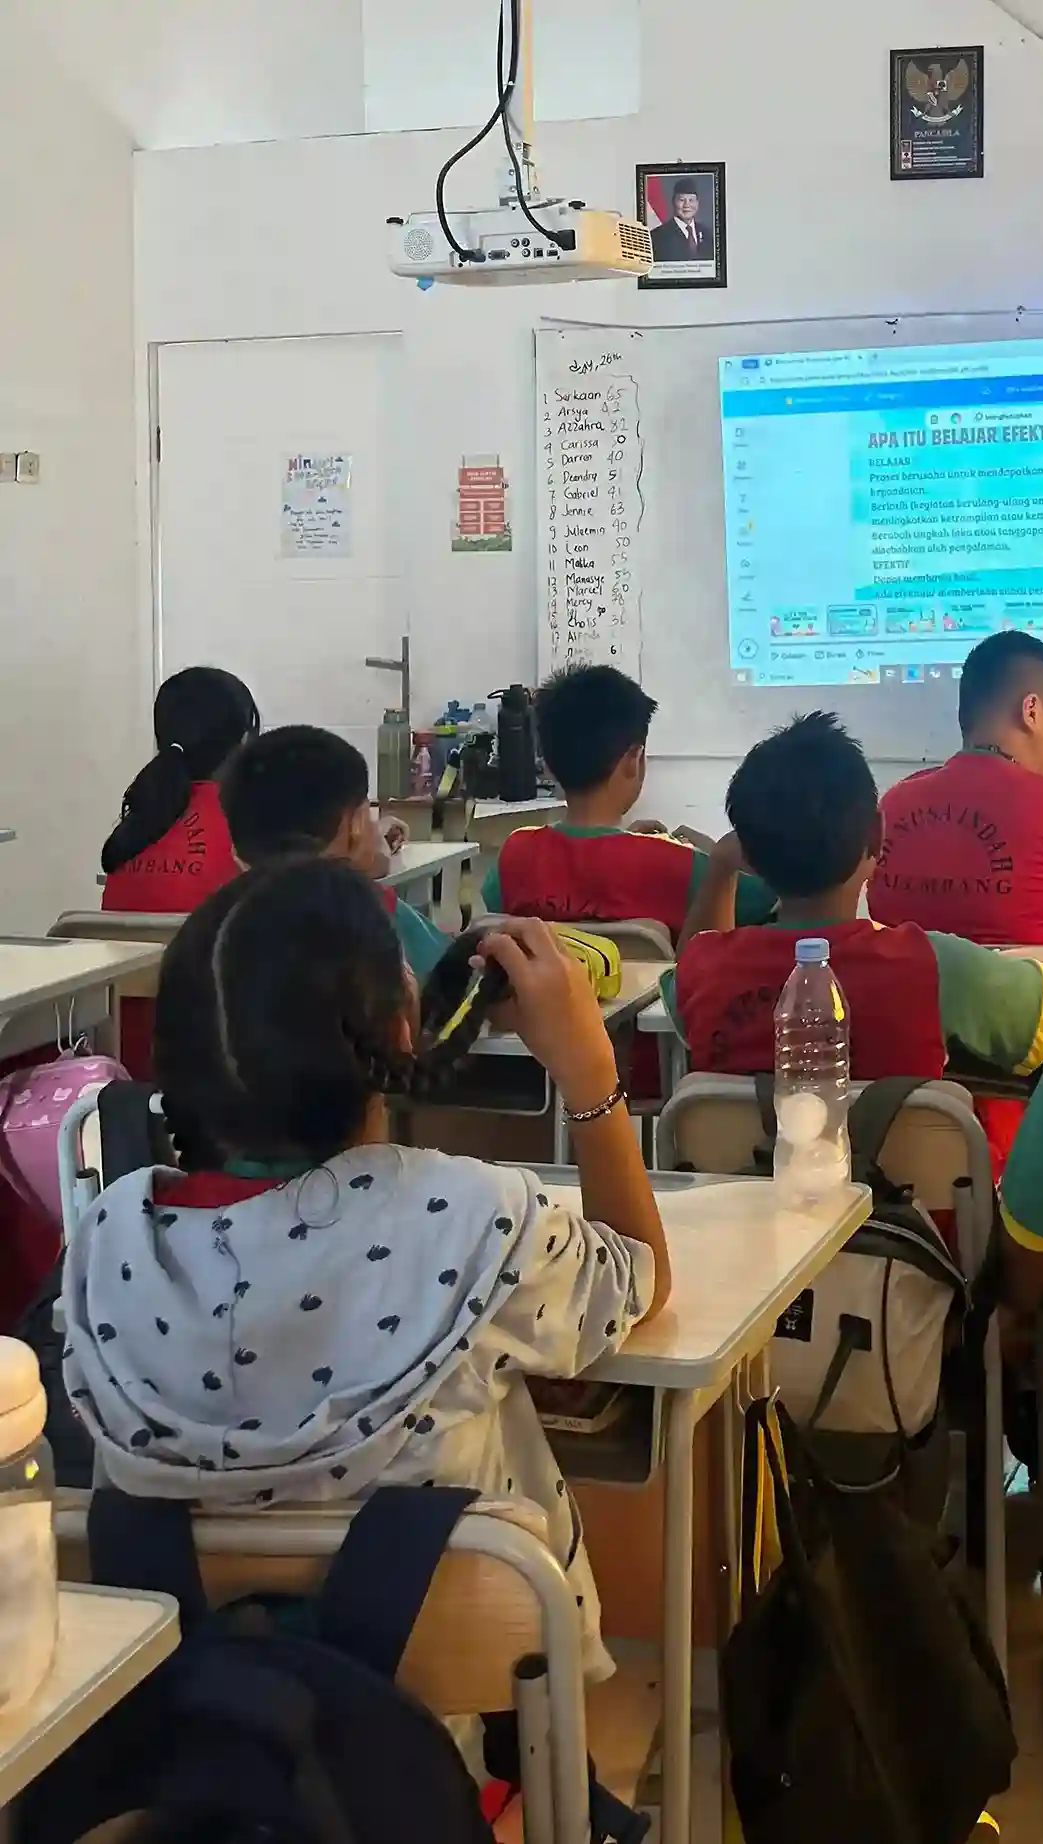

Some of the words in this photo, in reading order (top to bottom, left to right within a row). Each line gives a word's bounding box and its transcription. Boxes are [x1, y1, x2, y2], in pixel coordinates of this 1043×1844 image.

[868, 431, 900, 449] APA
[903, 430, 927, 448] ITU
[931, 427, 999, 446] BELAJAR
[561, 439, 599, 450] Carissa
[948, 468, 977, 478] untuk
[564, 486, 599, 500] Gabriel
